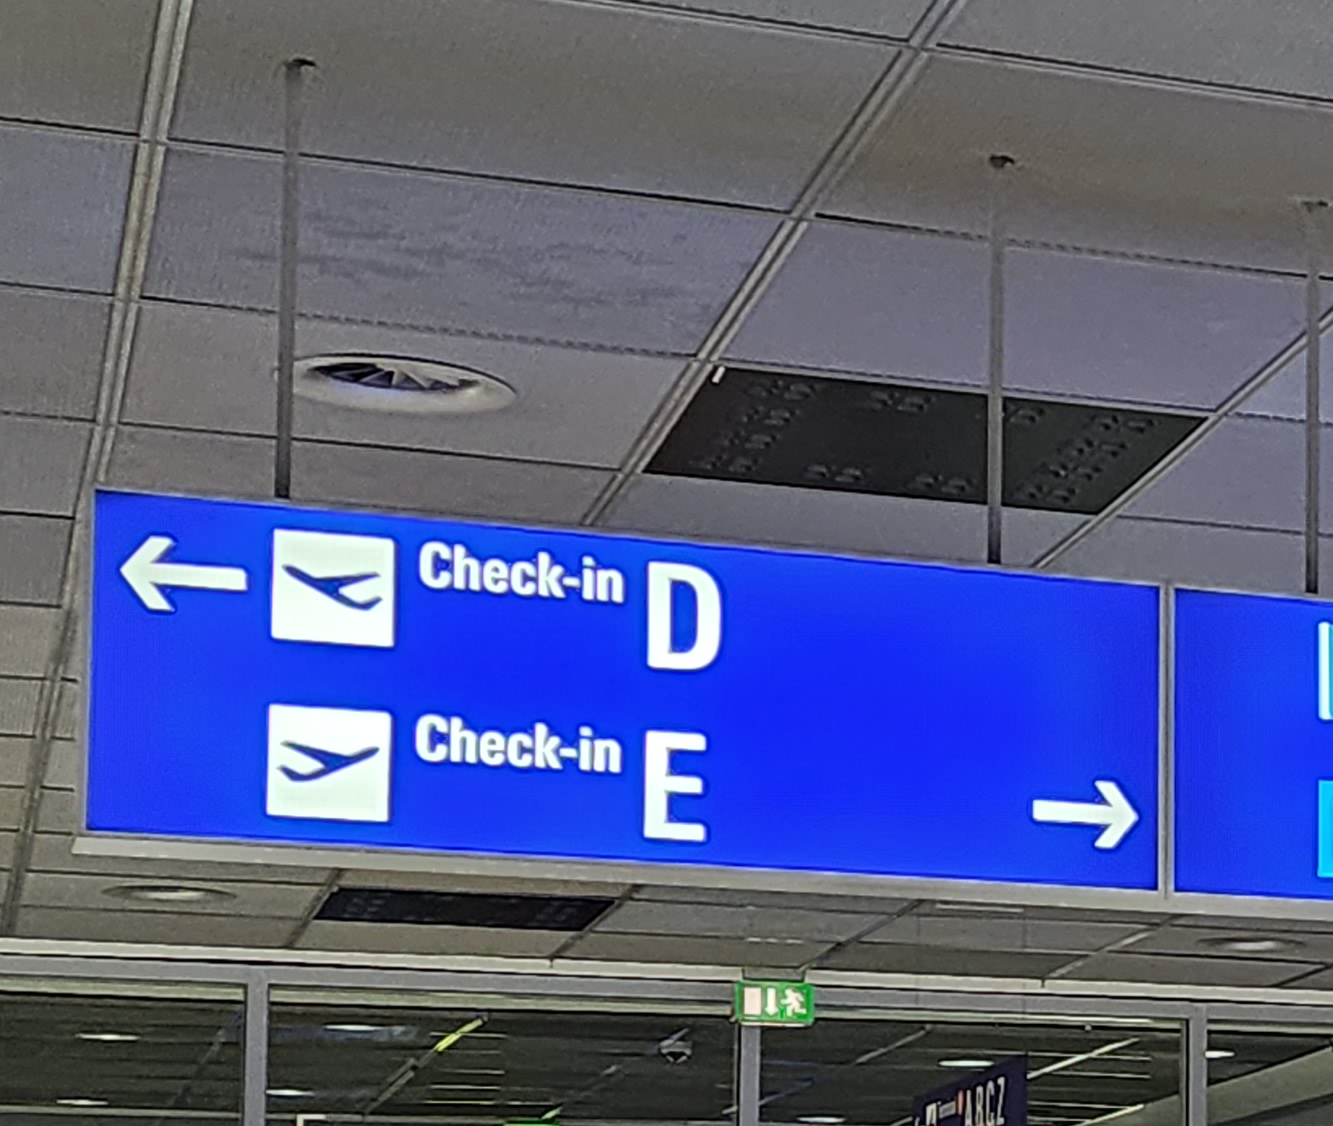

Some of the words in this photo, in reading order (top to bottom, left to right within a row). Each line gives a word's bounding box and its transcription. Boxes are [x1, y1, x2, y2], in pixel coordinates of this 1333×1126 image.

[419, 541, 625, 604] Check-in
[647, 561, 722, 671] D
[415, 713, 622, 774] Check-in
[643, 730, 707, 843] E
